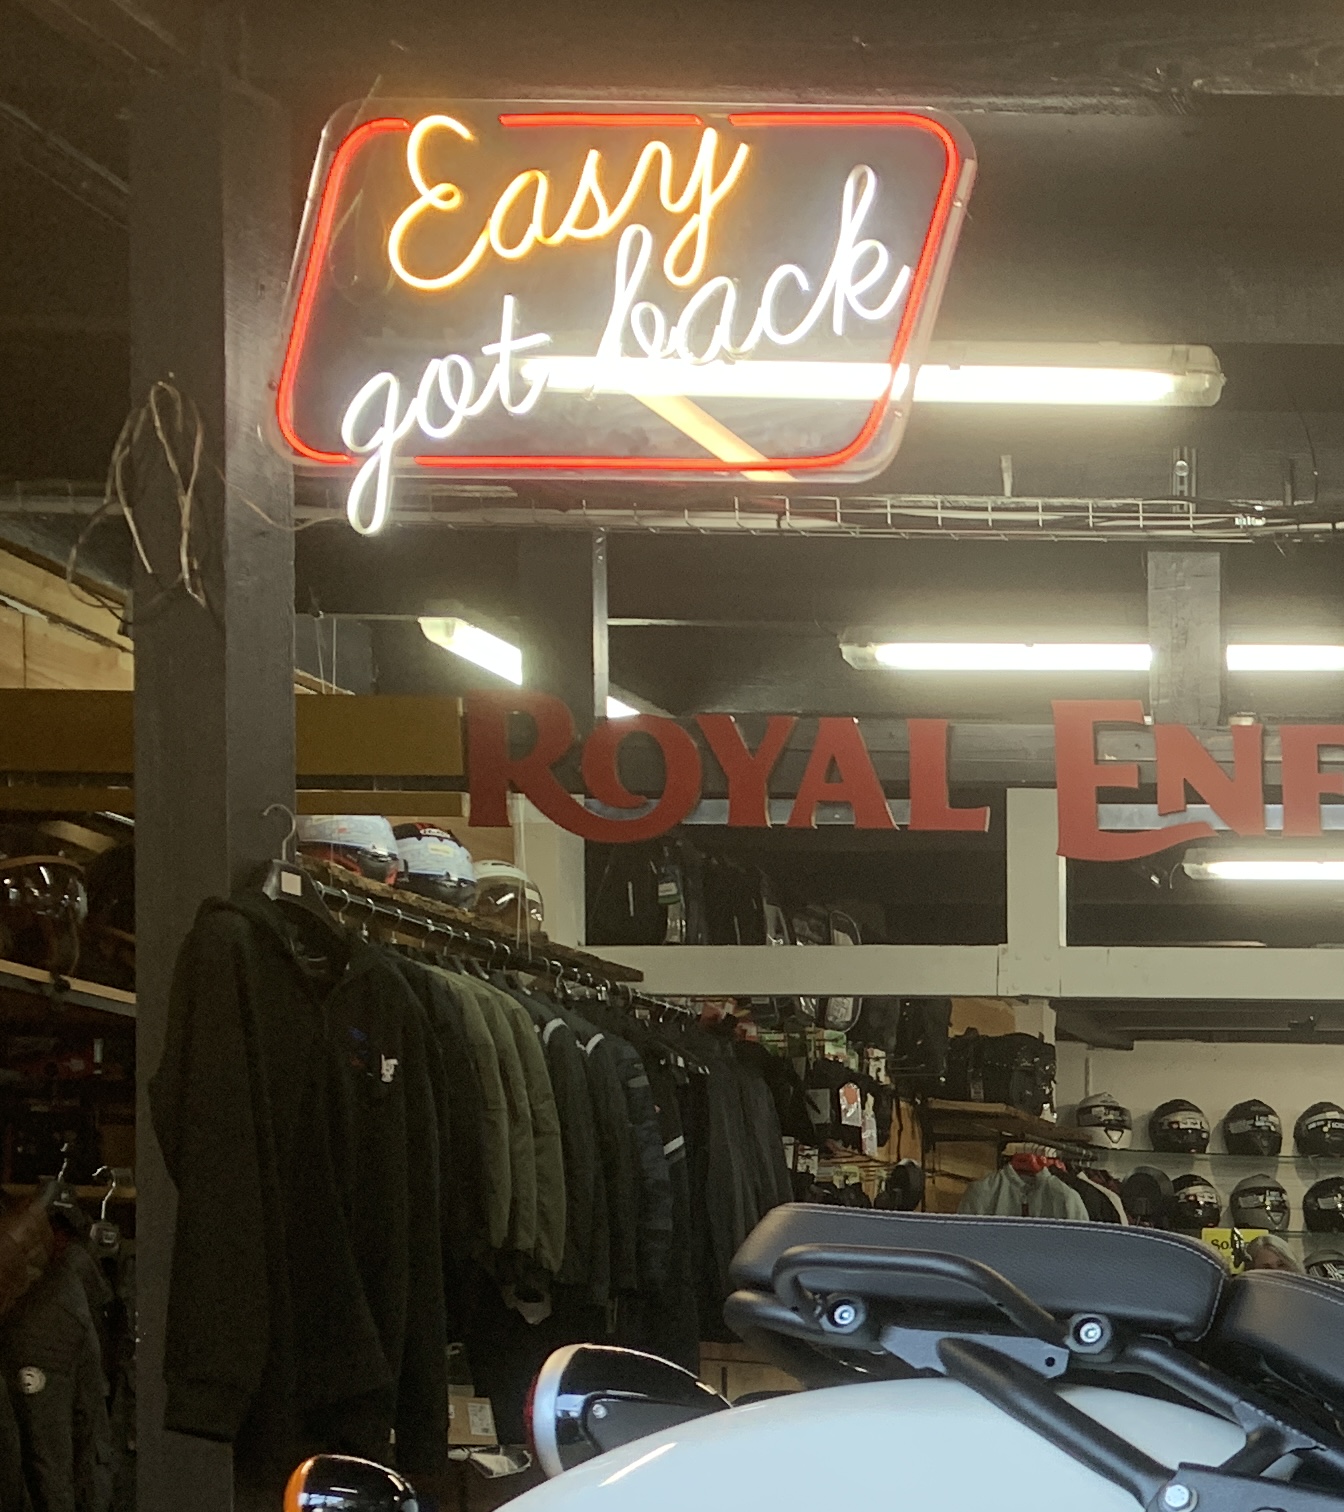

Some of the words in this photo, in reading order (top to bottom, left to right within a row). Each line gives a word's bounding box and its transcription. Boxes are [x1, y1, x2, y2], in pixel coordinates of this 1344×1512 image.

[388, 114, 751, 292] Easy
[342, 293, 555, 537] got
[594, 164, 914, 370] back
[463, 689, 992, 844] ROYAL
